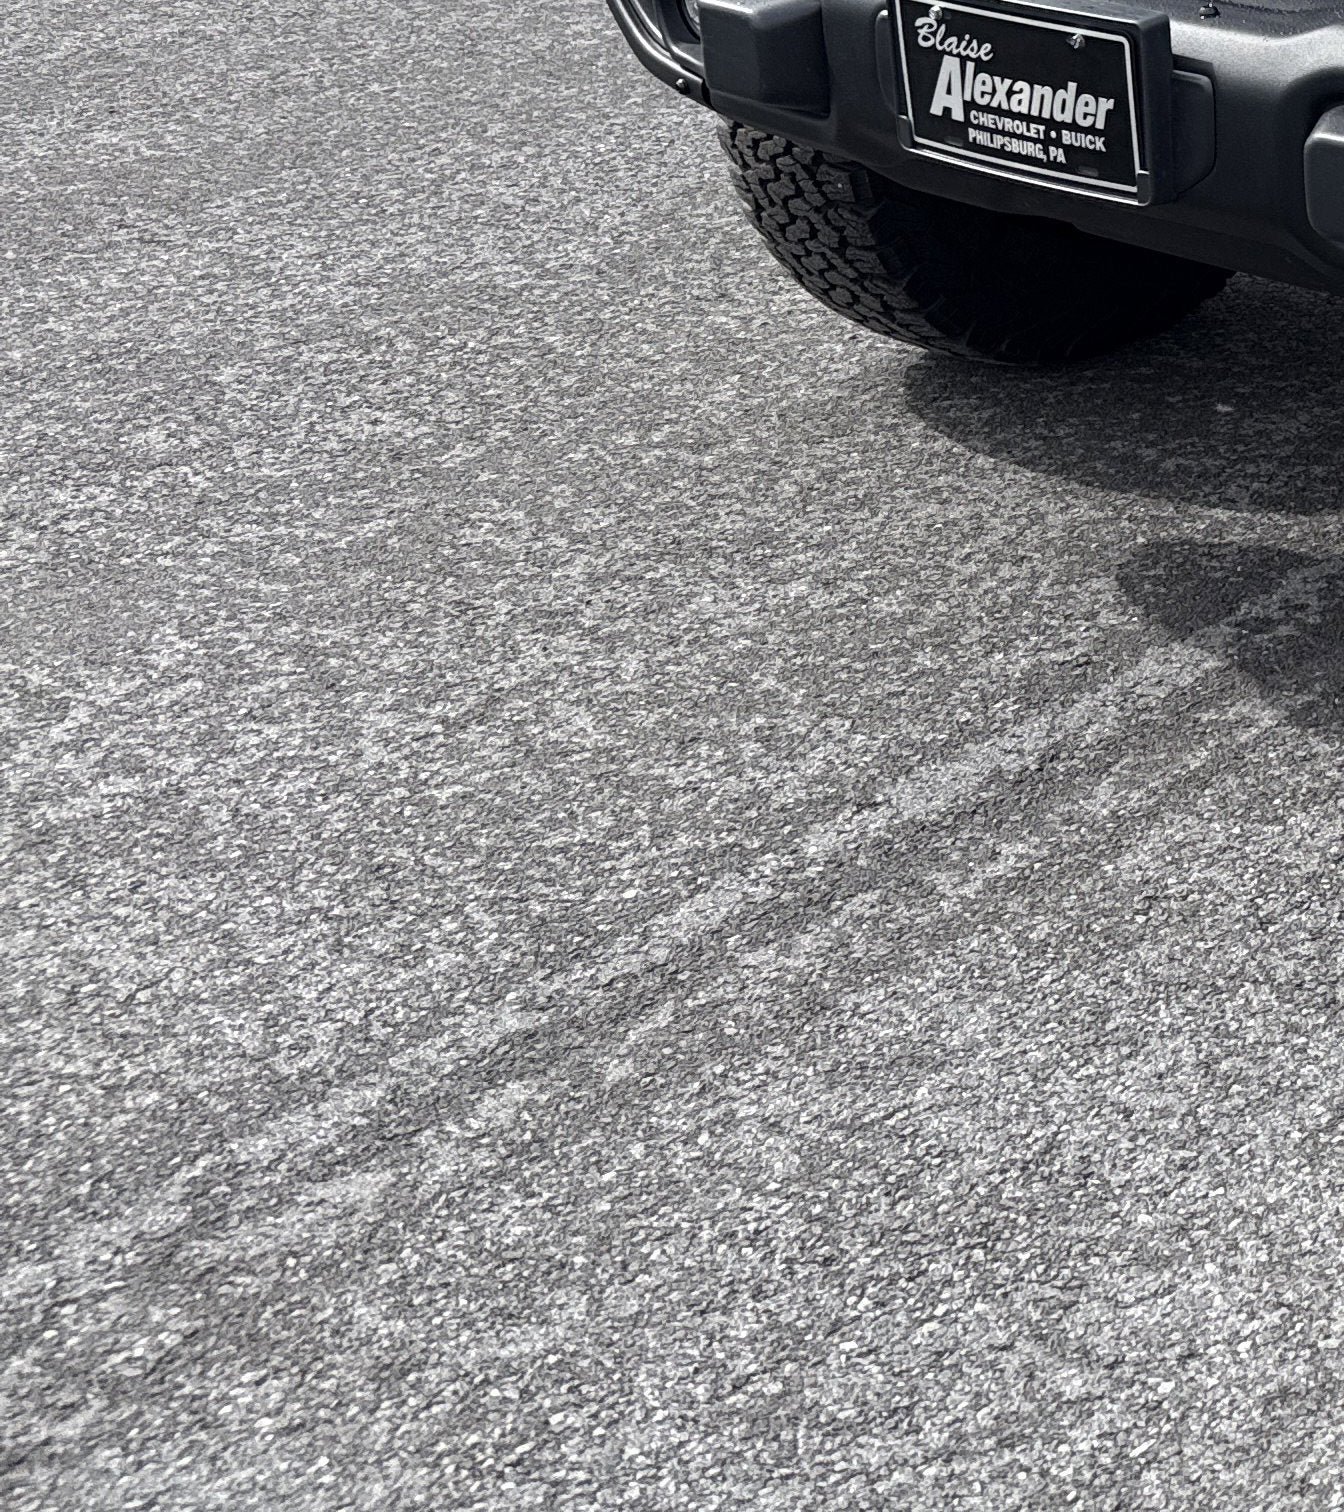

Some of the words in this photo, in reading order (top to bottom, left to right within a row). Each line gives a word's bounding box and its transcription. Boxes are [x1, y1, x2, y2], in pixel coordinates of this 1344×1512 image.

[914, 16, 994, 61] Blaise
[930, 55, 1115, 130] Alexander
[968, 128, 1047, 163] PHILIPSBURG,
[1048, 147, 1067, 164] PA
[970, 110, 1045, 140] CHEVROLET
[1061, 130, 1107, 153] BUICK
